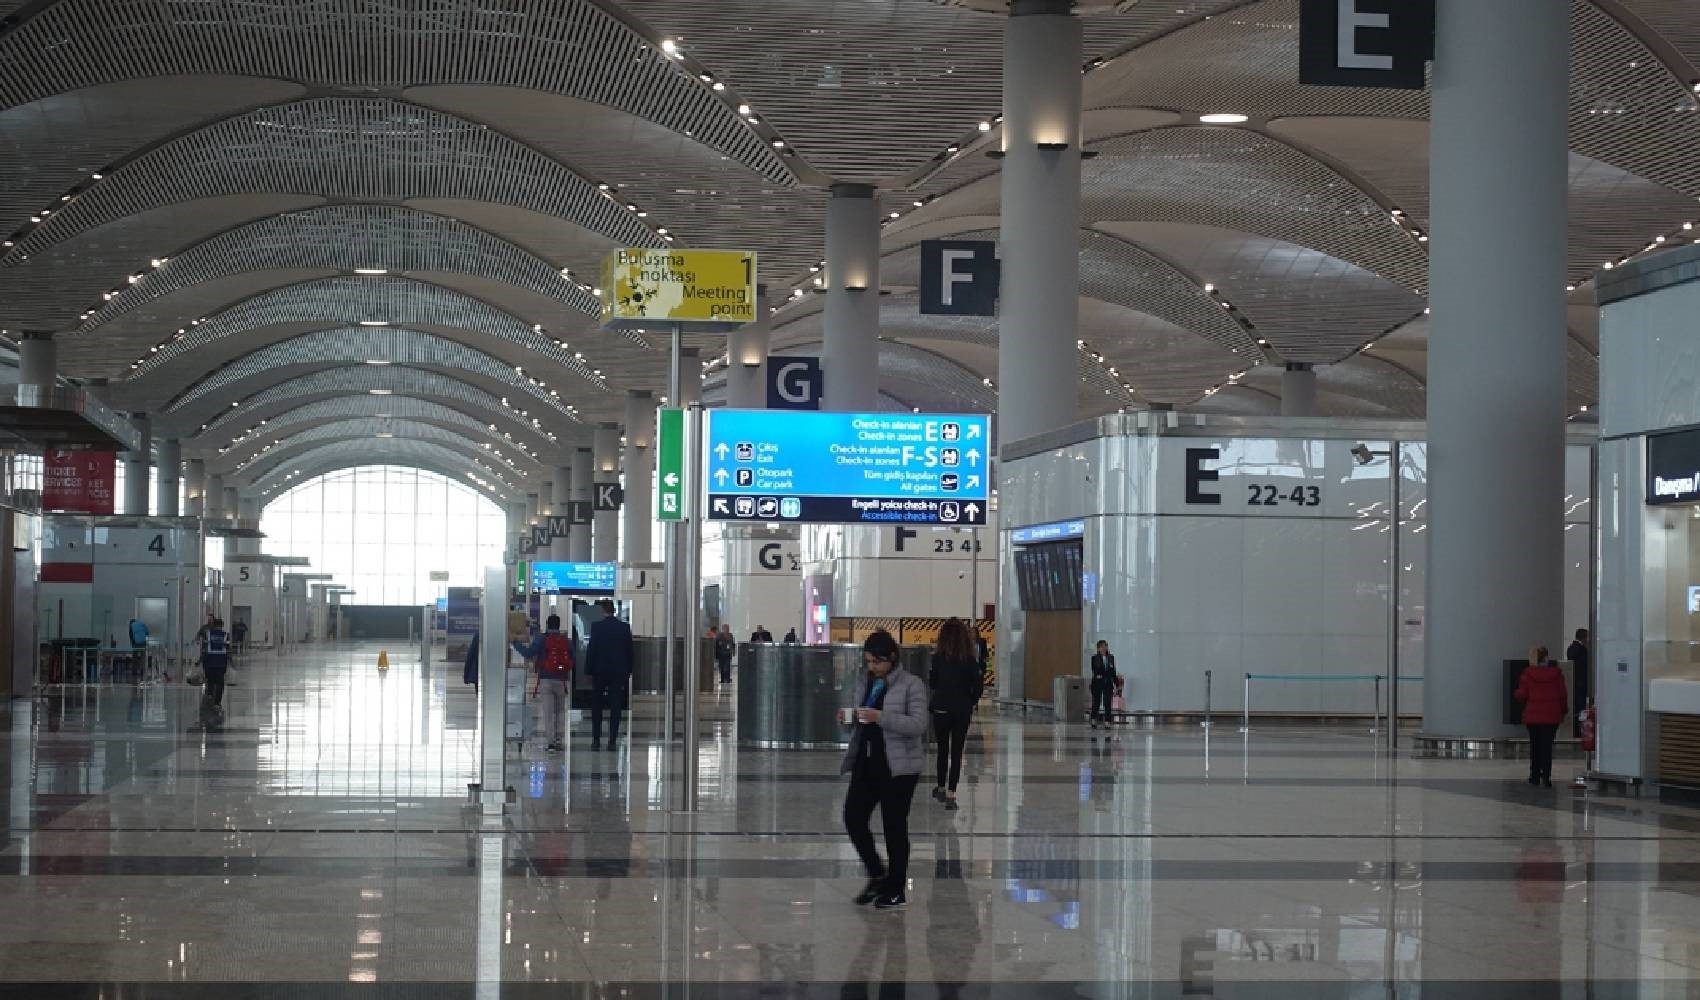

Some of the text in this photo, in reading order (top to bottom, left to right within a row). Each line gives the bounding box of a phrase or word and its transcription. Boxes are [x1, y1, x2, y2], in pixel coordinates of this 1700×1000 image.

[1338, 0, 1392, 70] E
[618, 251, 684, 268] Buluşma
[640, 268, 696, 282] noktası
[741, 258, 751, 285] 1
[941, 250, 975, 305] F
[683, 285, 745, 303] Meeting
[710, 303, 751, 316] point
[776, 363, 810, 402] G
[926, 421, 938, 442] E
[902, 445, 938, 467] F-S
[757, 467, 793, 478] Otopark
[1185, 448, 1221, 503] E
[599, 486, 614, 507] K
[1247, 484, 1320, 506] 22-43
[574, 503, 585, 522] L
[551, 518, 566, 535] M
[148, 534, 165, 556] 4
[536, 530, 548, 545] N
[895, 526, 916, 551] F
[759, 543, 781, 570] G
[240, 566, 249, 582] 5
[636, 571, 646, 589] J
